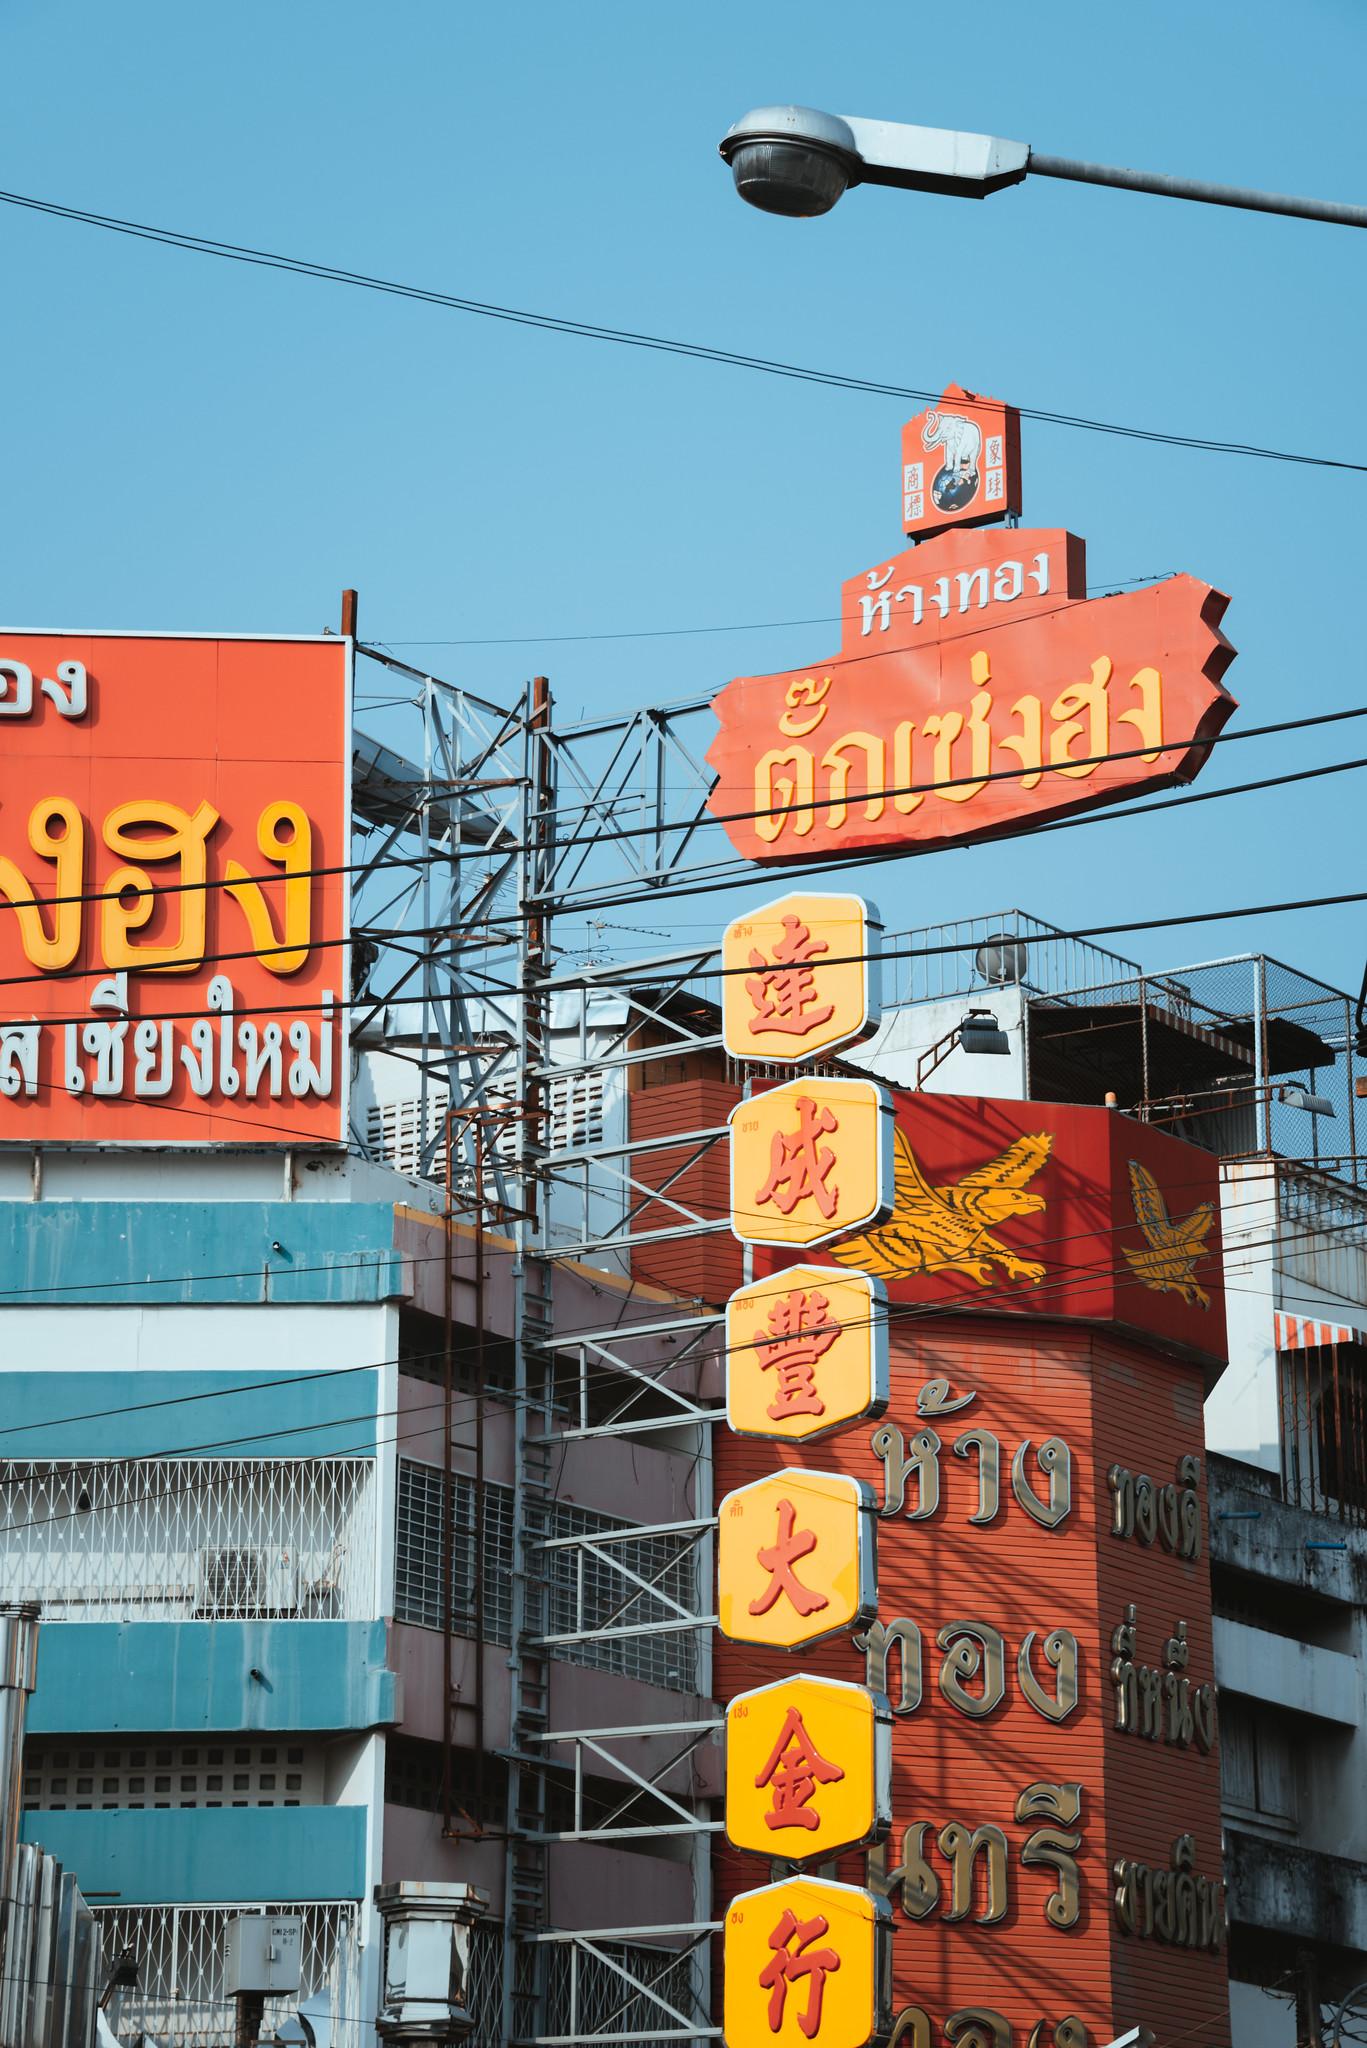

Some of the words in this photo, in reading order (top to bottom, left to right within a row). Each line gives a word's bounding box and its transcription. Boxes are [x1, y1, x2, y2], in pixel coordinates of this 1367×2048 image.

[858, 552, 1051, 636] ห้างทอง
[753, 650, 1165, 843] ตั๊กเซ่งฮง
[64, 971, 334, 1099] เชียงใหม่
[871, 1379, 1072, 1530] ห้าง
[853, 1617, 1079, 1724] ทอง
